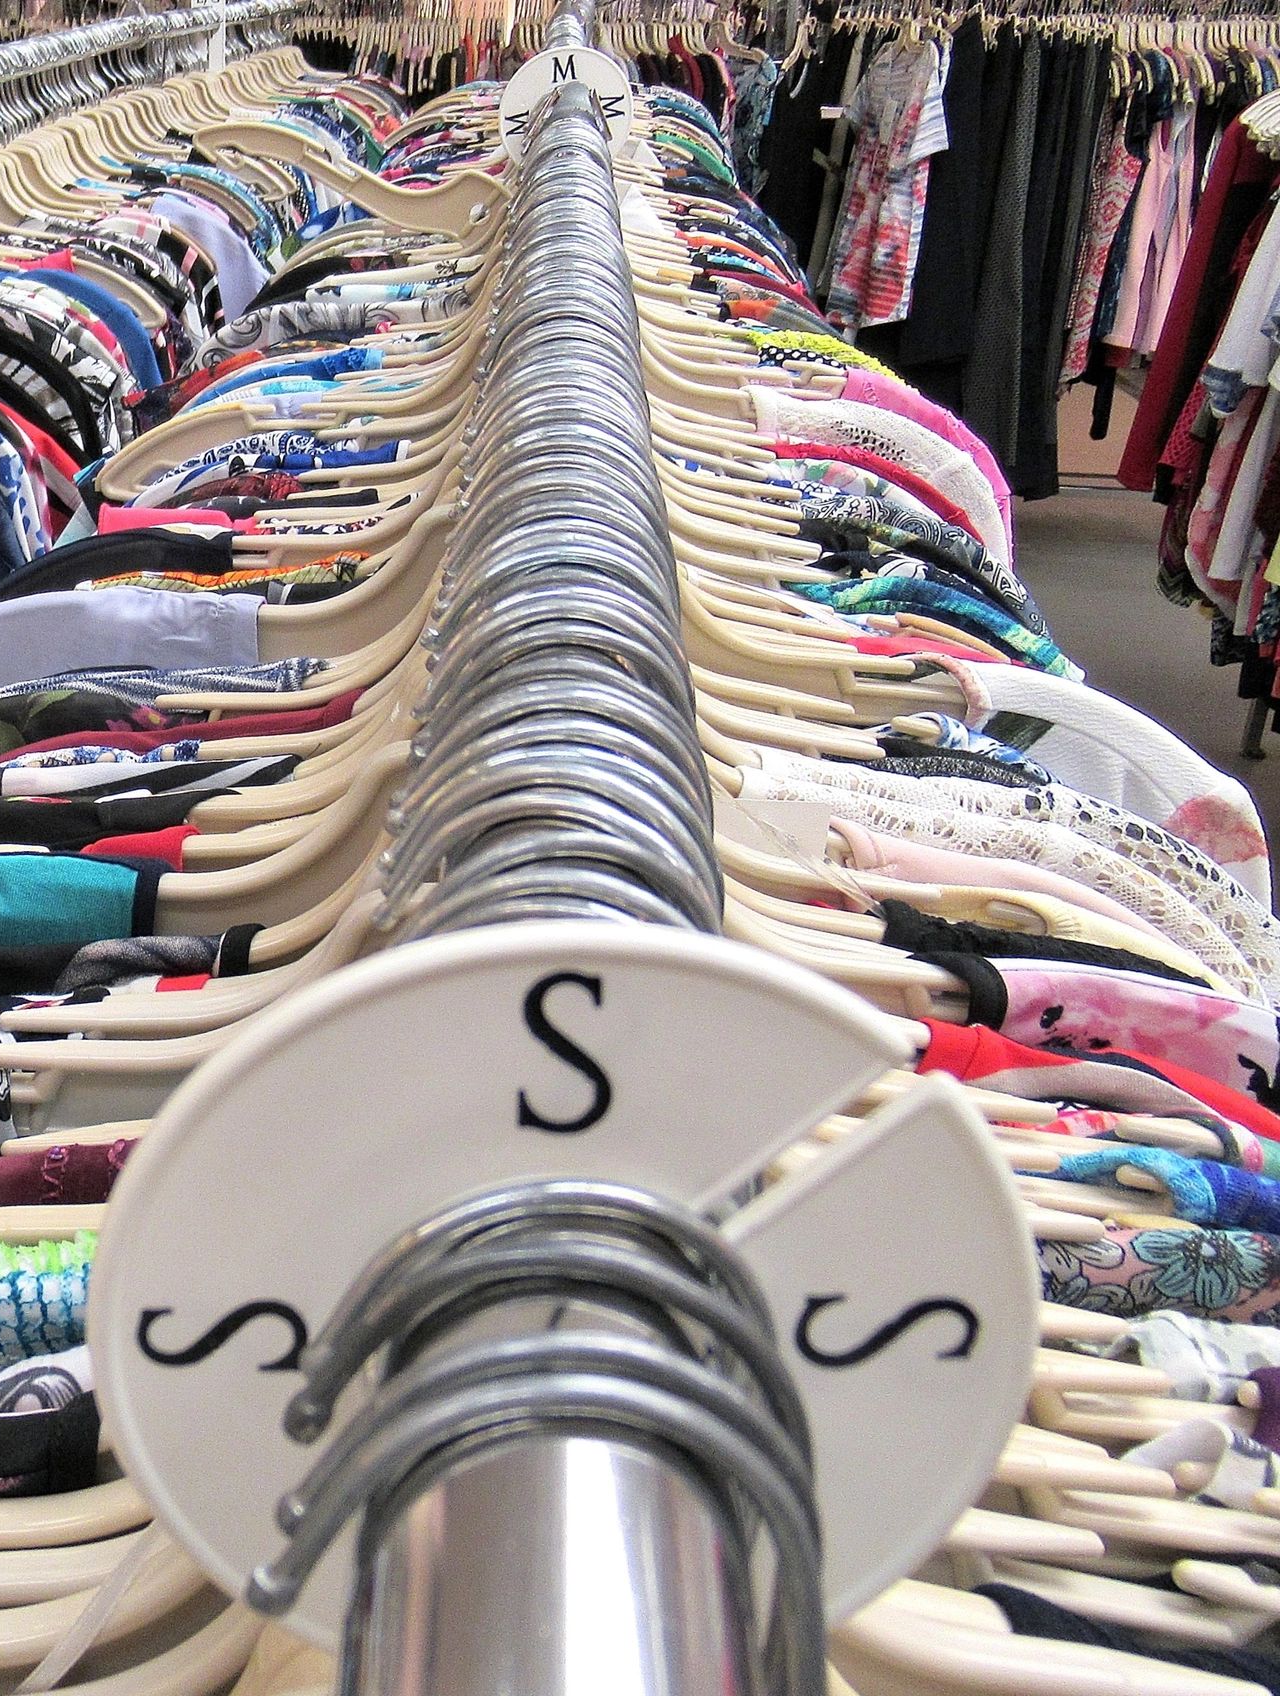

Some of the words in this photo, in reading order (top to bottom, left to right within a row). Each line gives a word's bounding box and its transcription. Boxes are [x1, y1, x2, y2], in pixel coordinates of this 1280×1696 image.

[552, 54, 577, 83] M
[504, 110, 530, 136] M
[599, 94, 625, 118] M
[517, 971, 612, 1133] S
[137, 1300, 307, 1371] S
[794, 1293, 980, 1368] S
